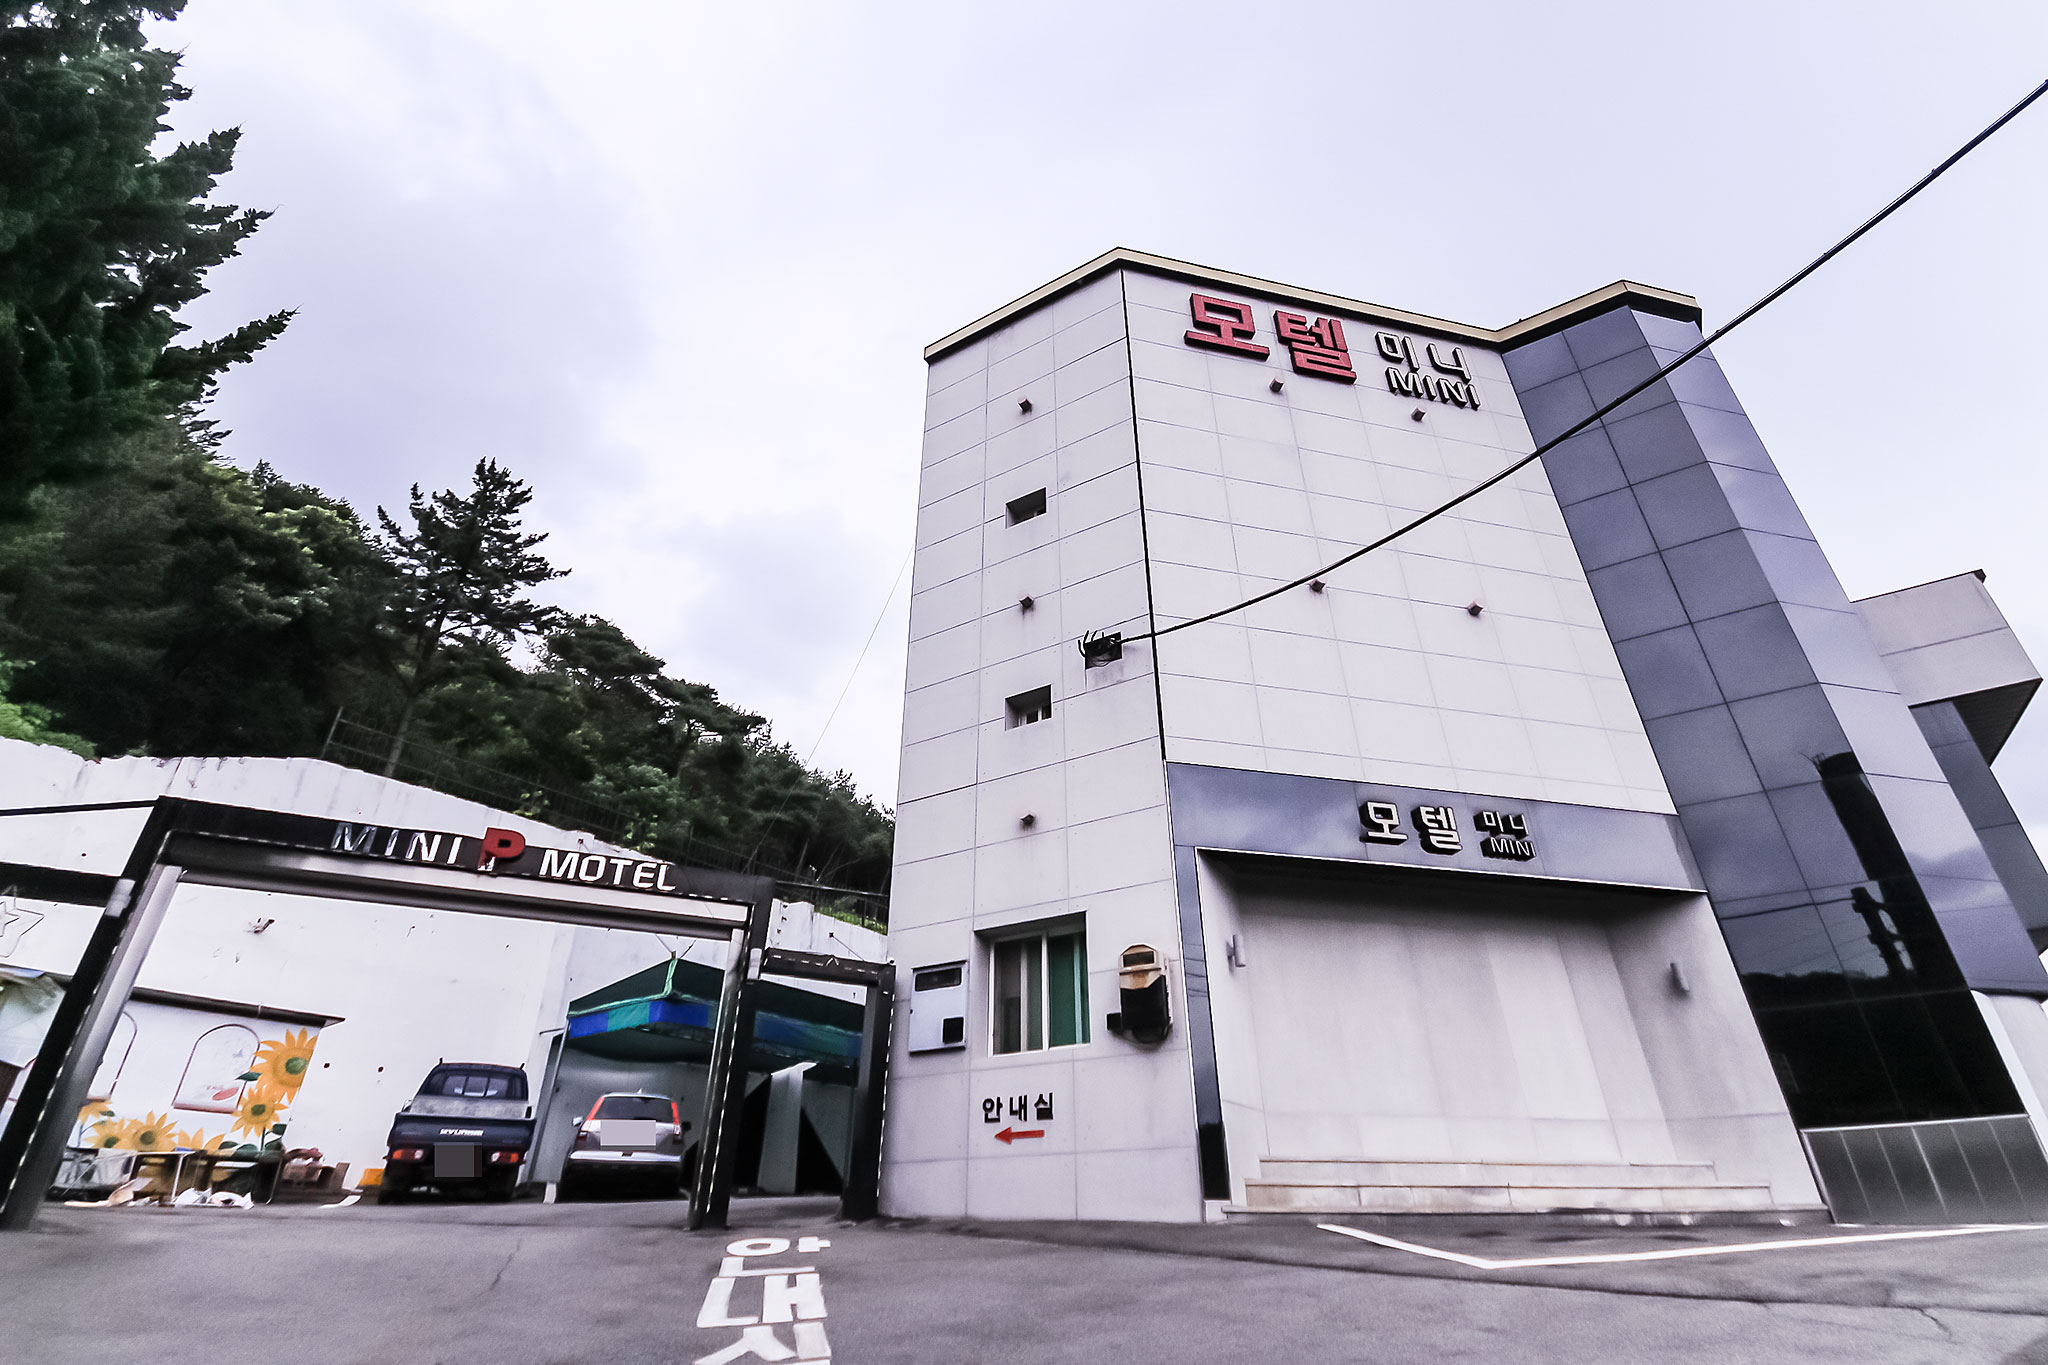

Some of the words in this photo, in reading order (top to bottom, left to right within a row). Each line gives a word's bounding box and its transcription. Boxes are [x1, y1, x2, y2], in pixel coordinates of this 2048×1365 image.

[1184, 292, 1357, 384] 모텔
[1375, 330, 1472, 383] 미니
[1385, 366, 1481, 411] MINI
[1361, 801, 1464, 854] 모텔
[1476, 809, 1530, 838] 미니
[1484, 836, 1537, 860] MINI
[330, 821, 464, 865] MINI
[476, 826, 527, 872] P
[538, 848, 677, 892] MOTEL
[982, 1092, 1054, 1123] 안내실
